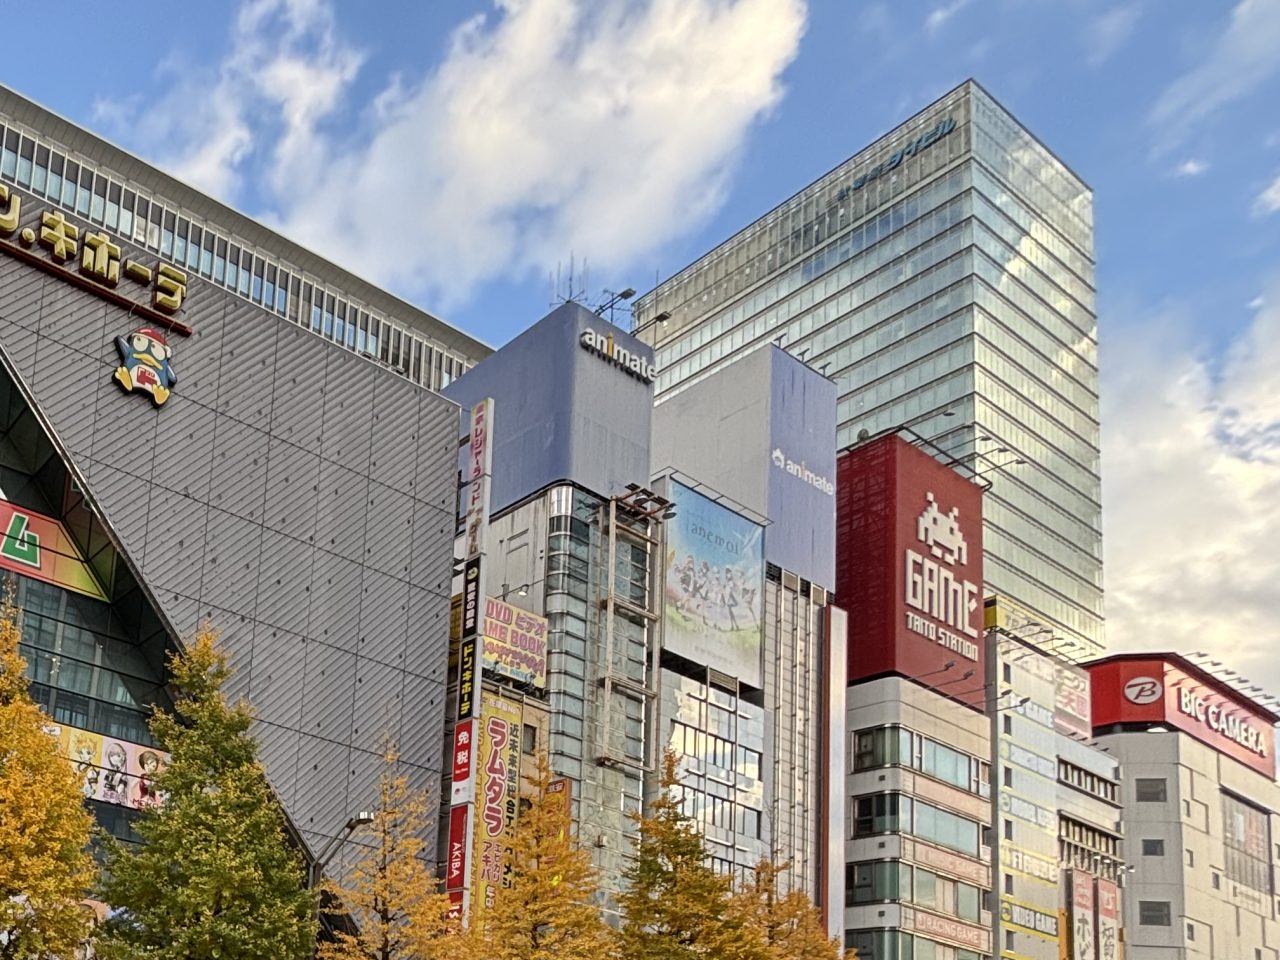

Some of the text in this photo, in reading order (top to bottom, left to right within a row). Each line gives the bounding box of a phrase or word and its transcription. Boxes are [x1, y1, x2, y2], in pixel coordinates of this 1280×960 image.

[582, 326, 657, 383] animate
[785, 459, 834, 497] animate
[691, 523, 738, 555] anemoi
[905, 549, 978, 637] GAME
[485, 601, 513, 625] DVD
[511, 629, 545, 657] BOOK
[905, 611, 978, 662] TAITO STATION
[1179, 686, 1267, 758] BIC CAMERA
[456, 731, 469, 765] 免税
[482, 716, 508, 836] ラムタラ
[451, 842, 462, 879] AKIBA
[927, 918, 979, 944] RACING GAME
[1035, 910, 1057, 935] GAME
